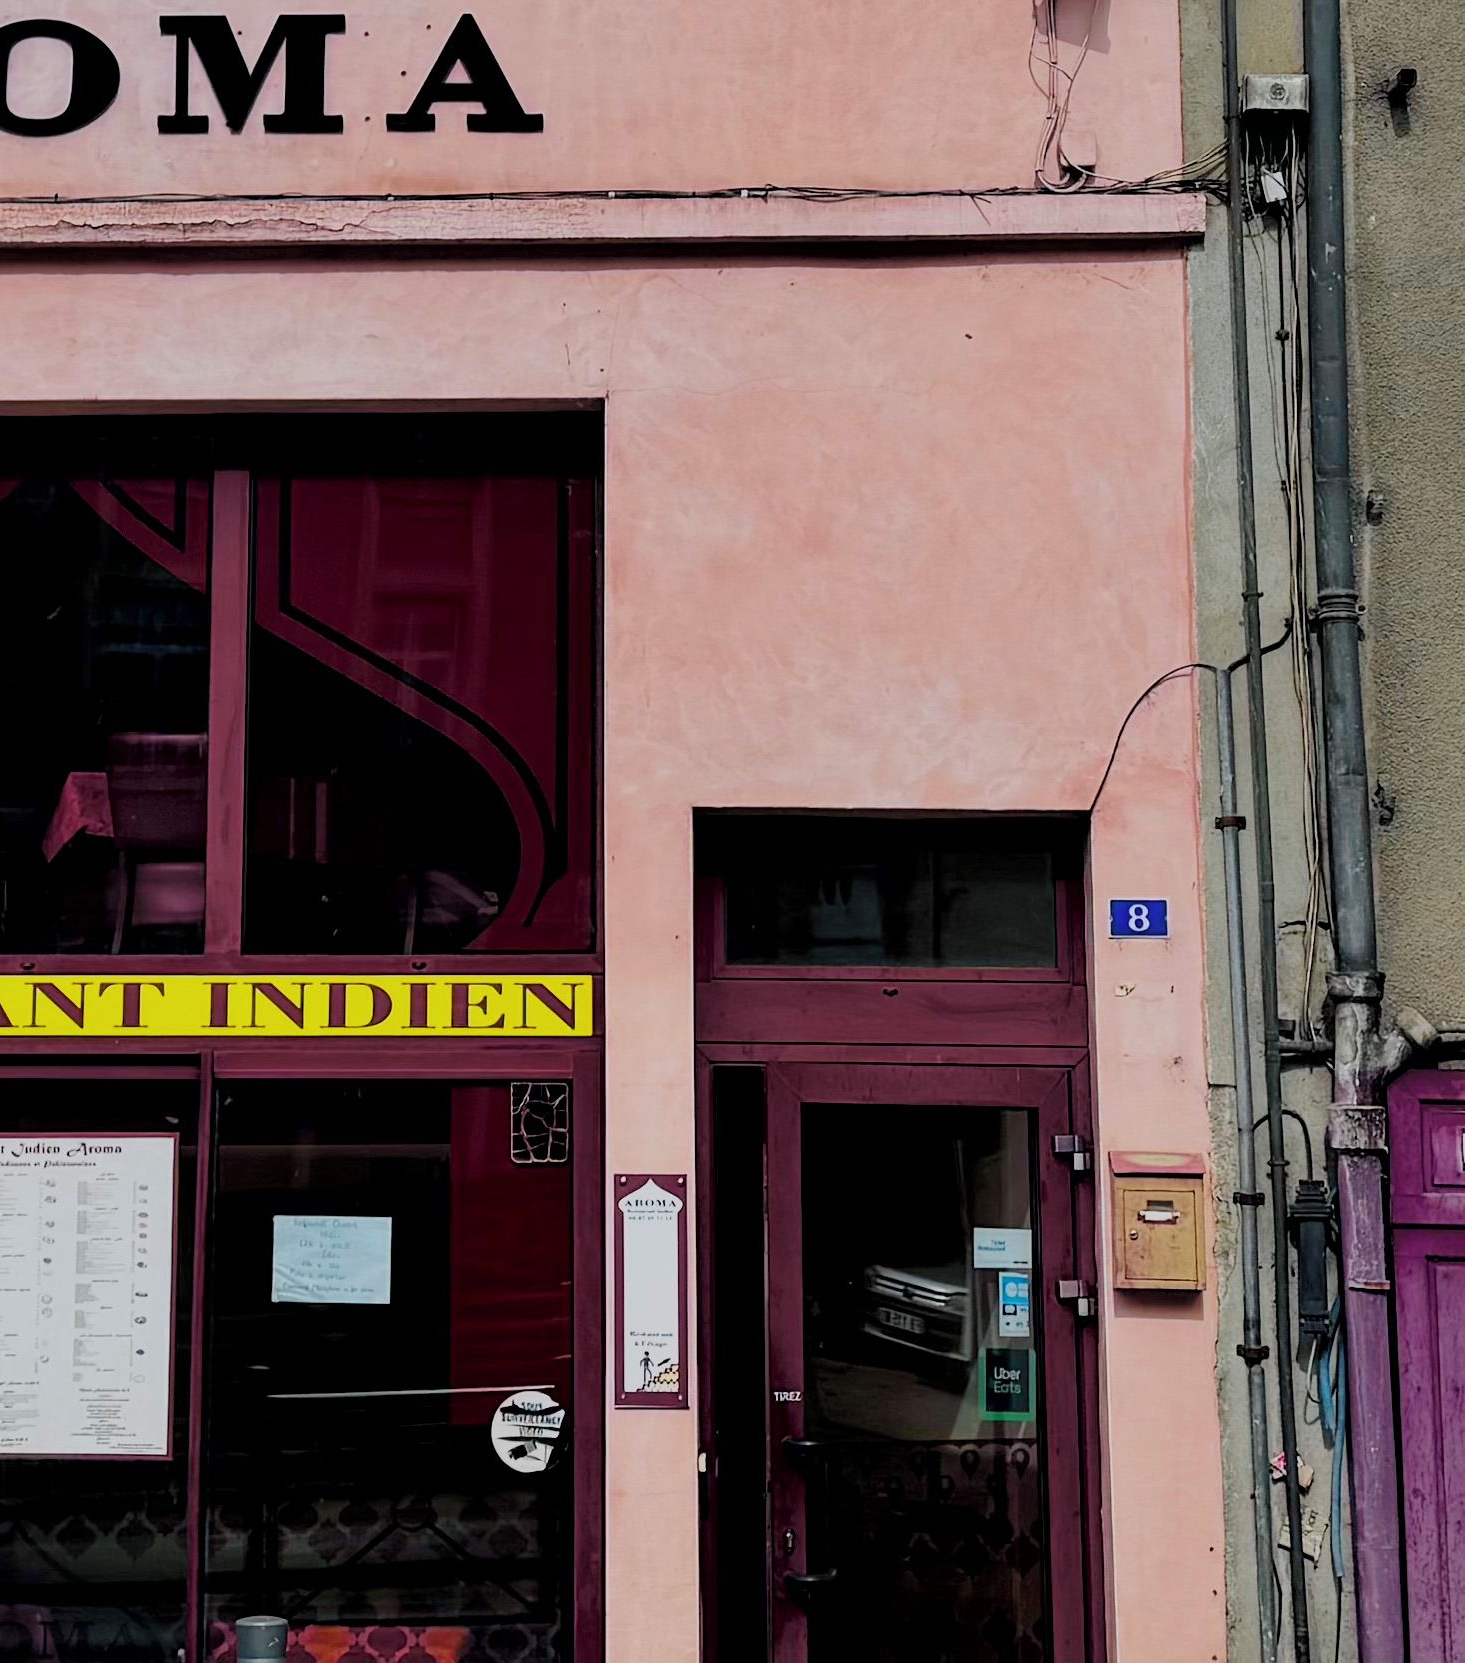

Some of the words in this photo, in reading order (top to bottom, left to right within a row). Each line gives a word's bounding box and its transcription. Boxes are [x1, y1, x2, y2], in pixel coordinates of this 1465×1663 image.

[1128, 903, 1150, 932] 8
[201, 978, 586, 1030] INDIEN
[625, 1199, 677, 1208] AROMA
[993, 1366, 1021, 1380] Uber
[993, 1381, 1022, 1394] Eats
[773, 1391, 802, 1402] TIREZ
